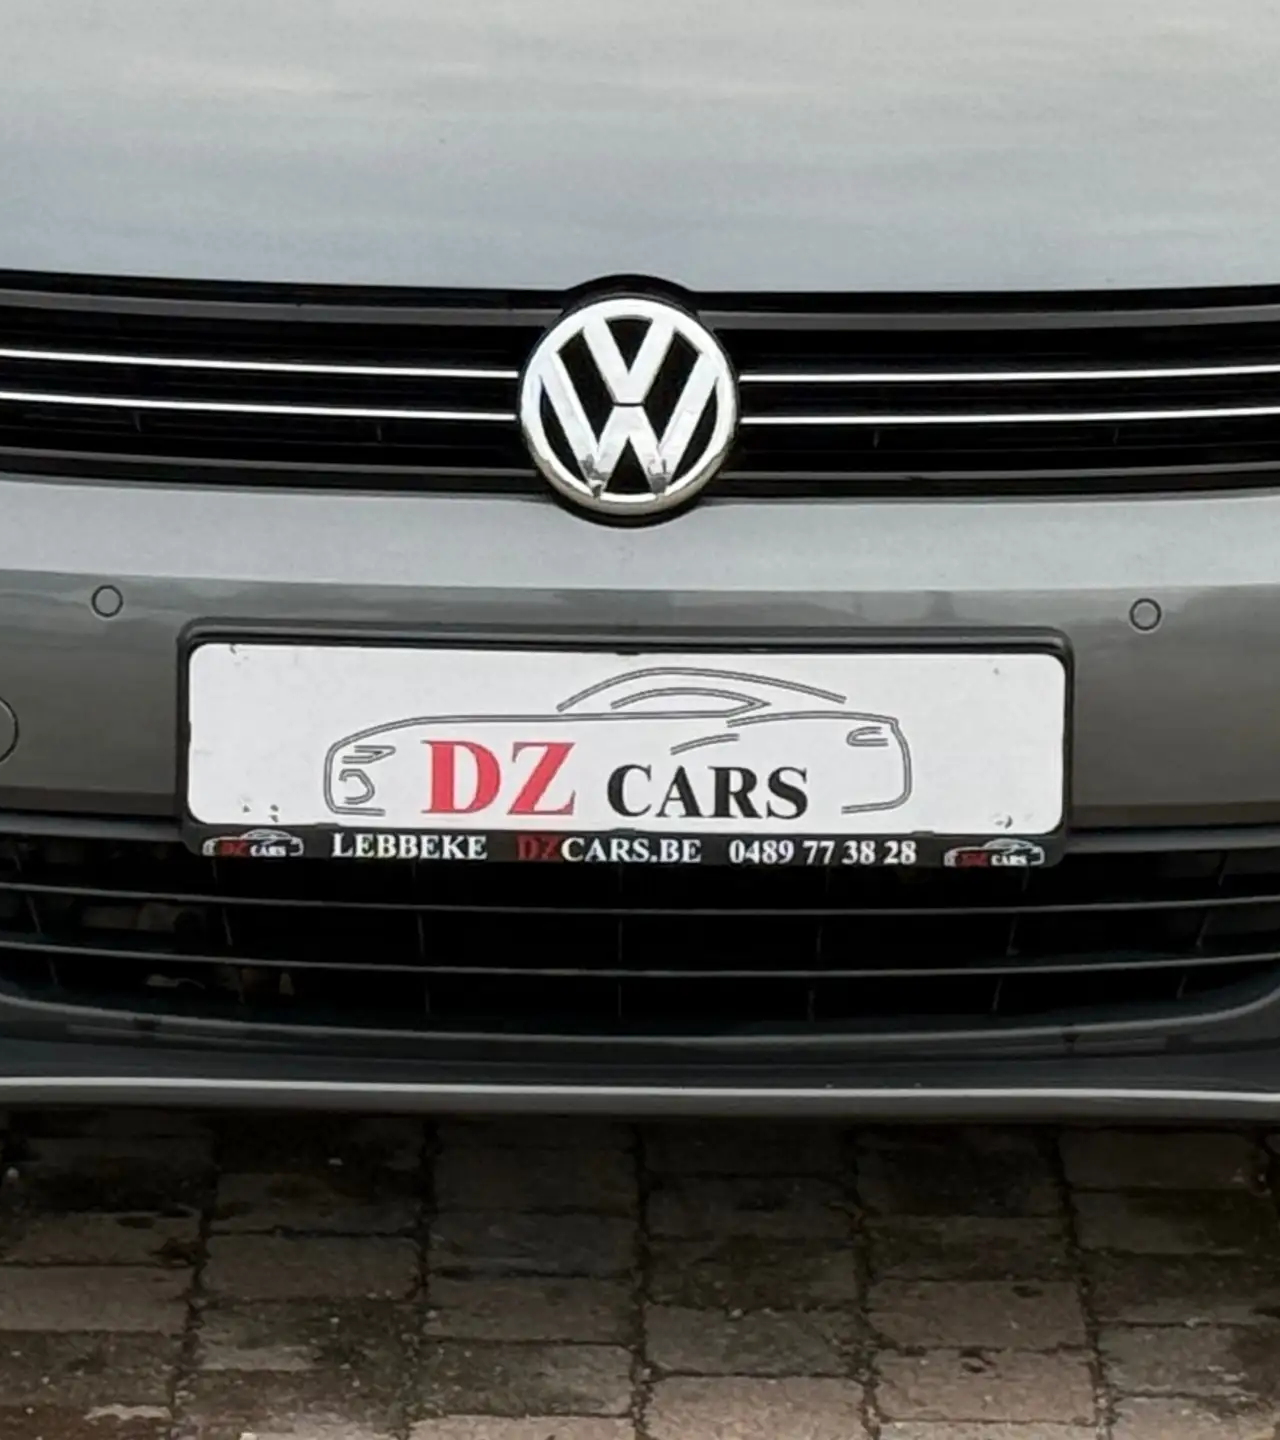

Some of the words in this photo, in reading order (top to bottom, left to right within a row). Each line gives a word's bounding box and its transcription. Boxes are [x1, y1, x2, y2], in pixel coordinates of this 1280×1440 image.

[527, 302, 731, 506] VW
[420, 739, 577, 816] DZ
[606, 763, 810, 820] CARS
[331, 832, 488, 860] LEBBEKE
[517, 836, 702, 863] DZCARS.BE
[728, 839, 795, 864] 0489
[802, 840, 836, 865] 77
[841, 840, 876, 865] 38
[883, 840, 917, 865] 28
